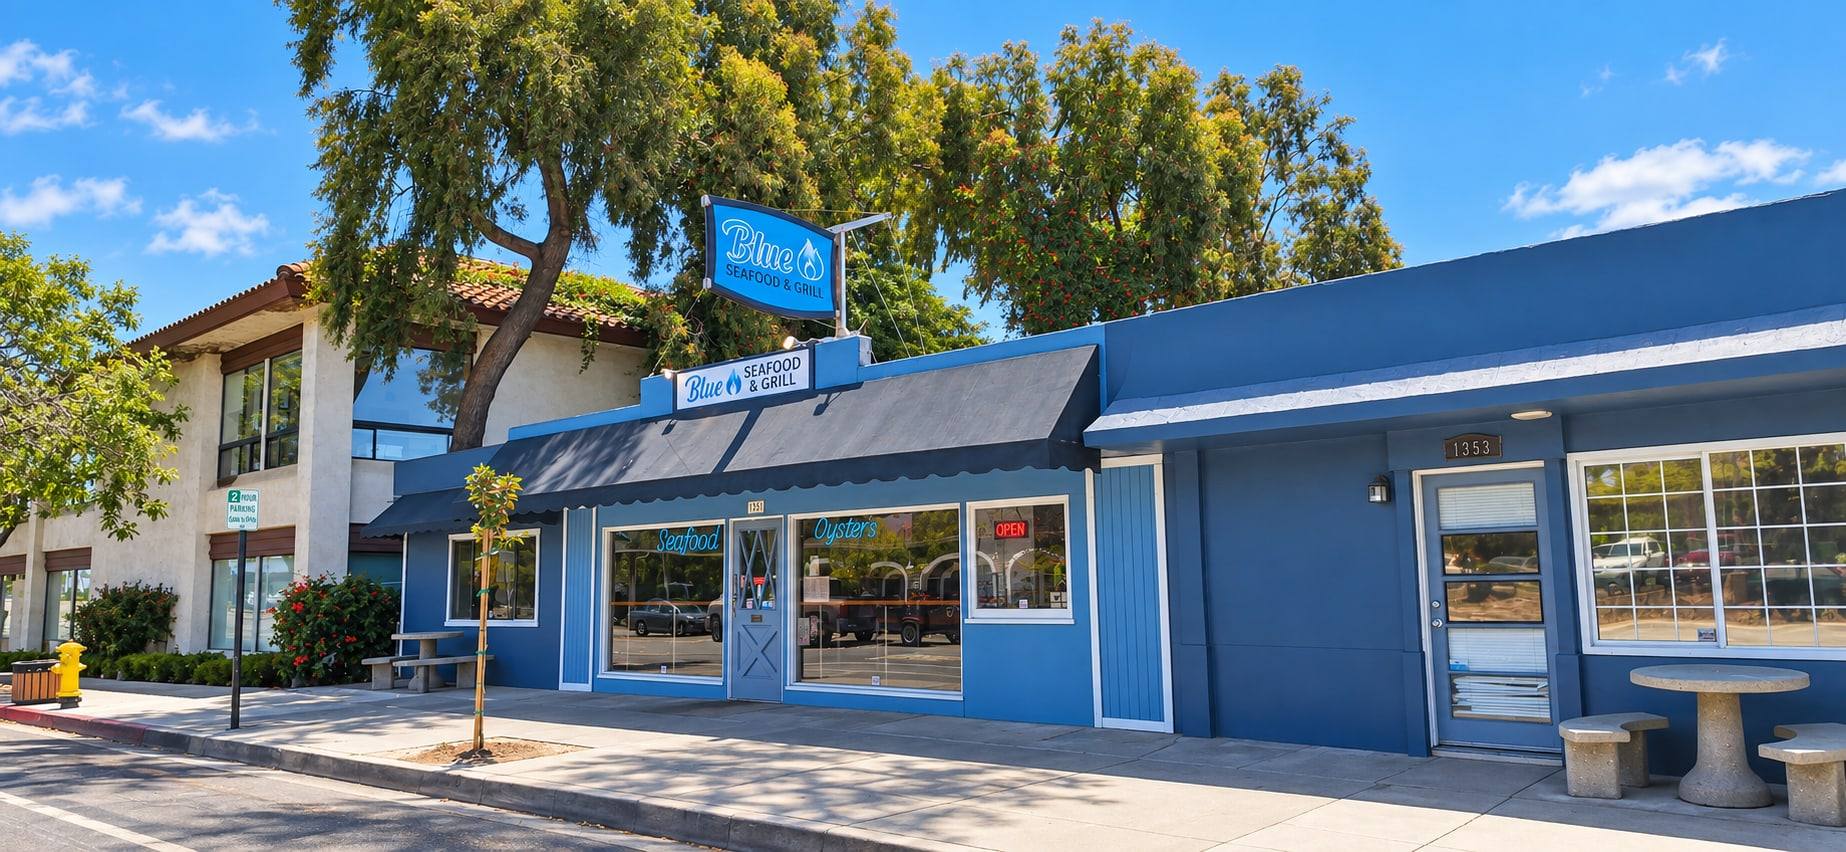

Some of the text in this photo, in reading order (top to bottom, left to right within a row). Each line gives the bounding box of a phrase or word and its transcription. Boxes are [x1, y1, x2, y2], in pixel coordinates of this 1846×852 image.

[722, 219, 793, 274] Blue
[726, 264, 824, 299] SEAFOOD & GRILL
[744, 356, 801, 378] SEAFOOD
[685, 374, 723, 402] Blue
[749, 373, 797, 392] & GRILL
[1454, 440, 1490, 457] 1353
[231, 492, 238, 502] 2
[656, 524, 721, 556] Seafood
[996, 522, 1025, 537] OPEN
